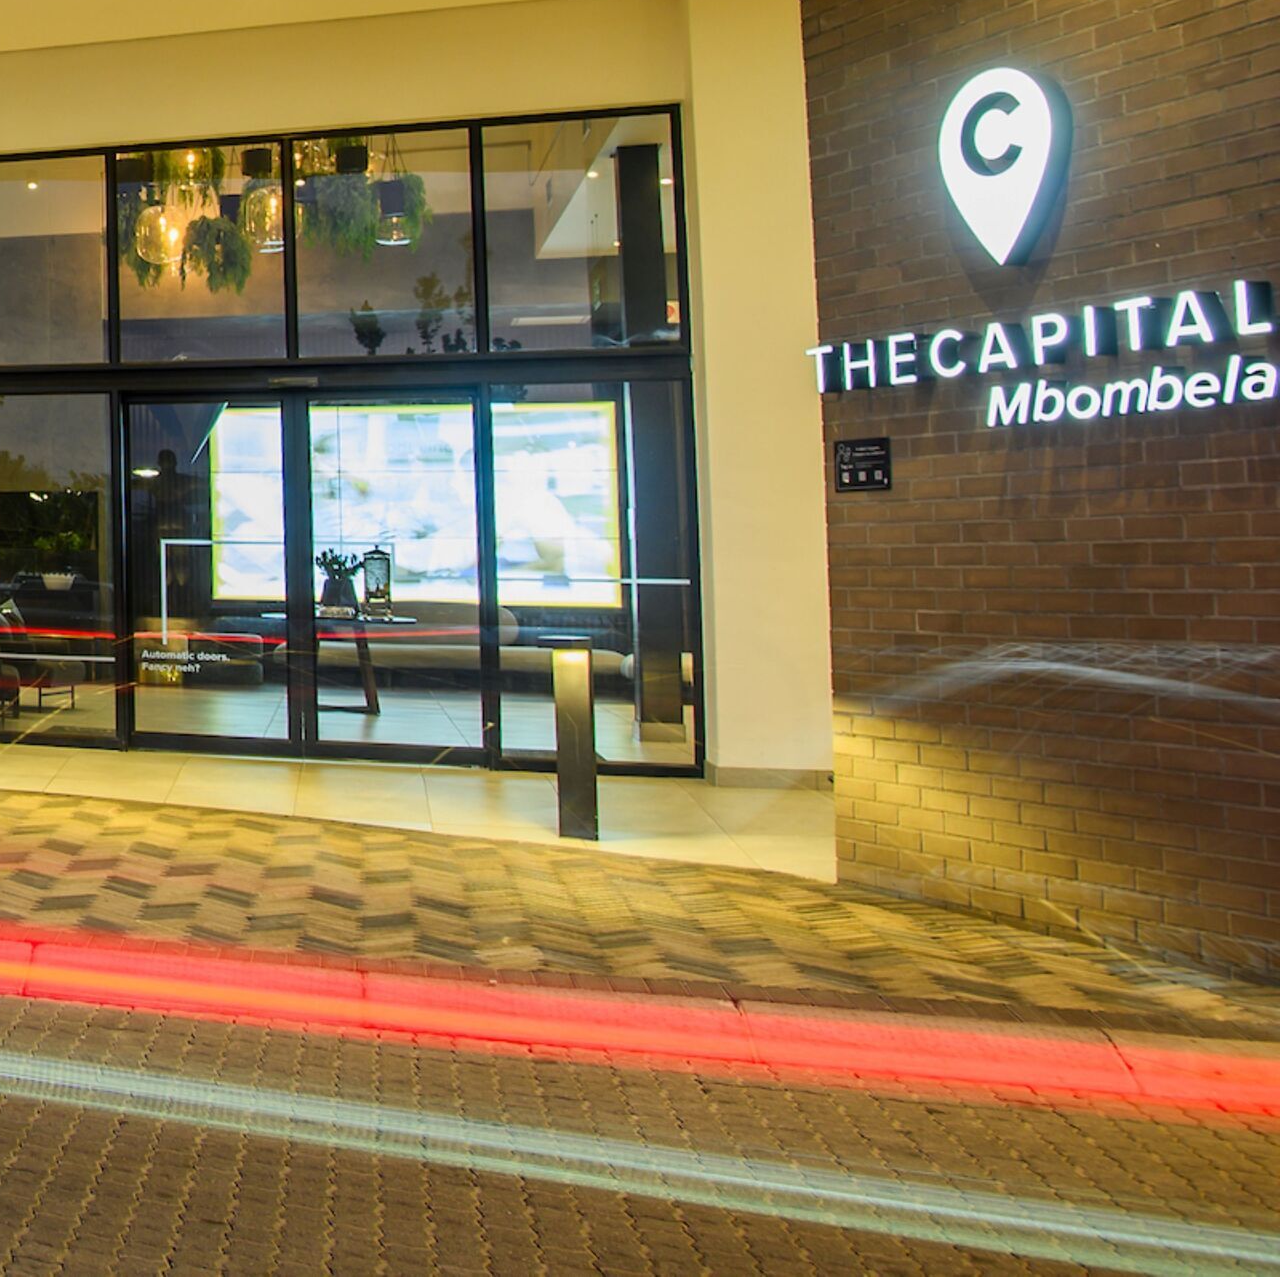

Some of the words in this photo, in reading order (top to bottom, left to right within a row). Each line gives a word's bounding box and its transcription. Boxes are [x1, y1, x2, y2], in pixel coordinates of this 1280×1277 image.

[960, 91, 1023, 176] C
[986, 353, 1278, 428] Mbombela
[141, 649, 195, 661] Automatic
[197, 651, 231, 662] doors.
[142, 661, 173, 673] Fancy
[175, 663, 201, 674] neh?
